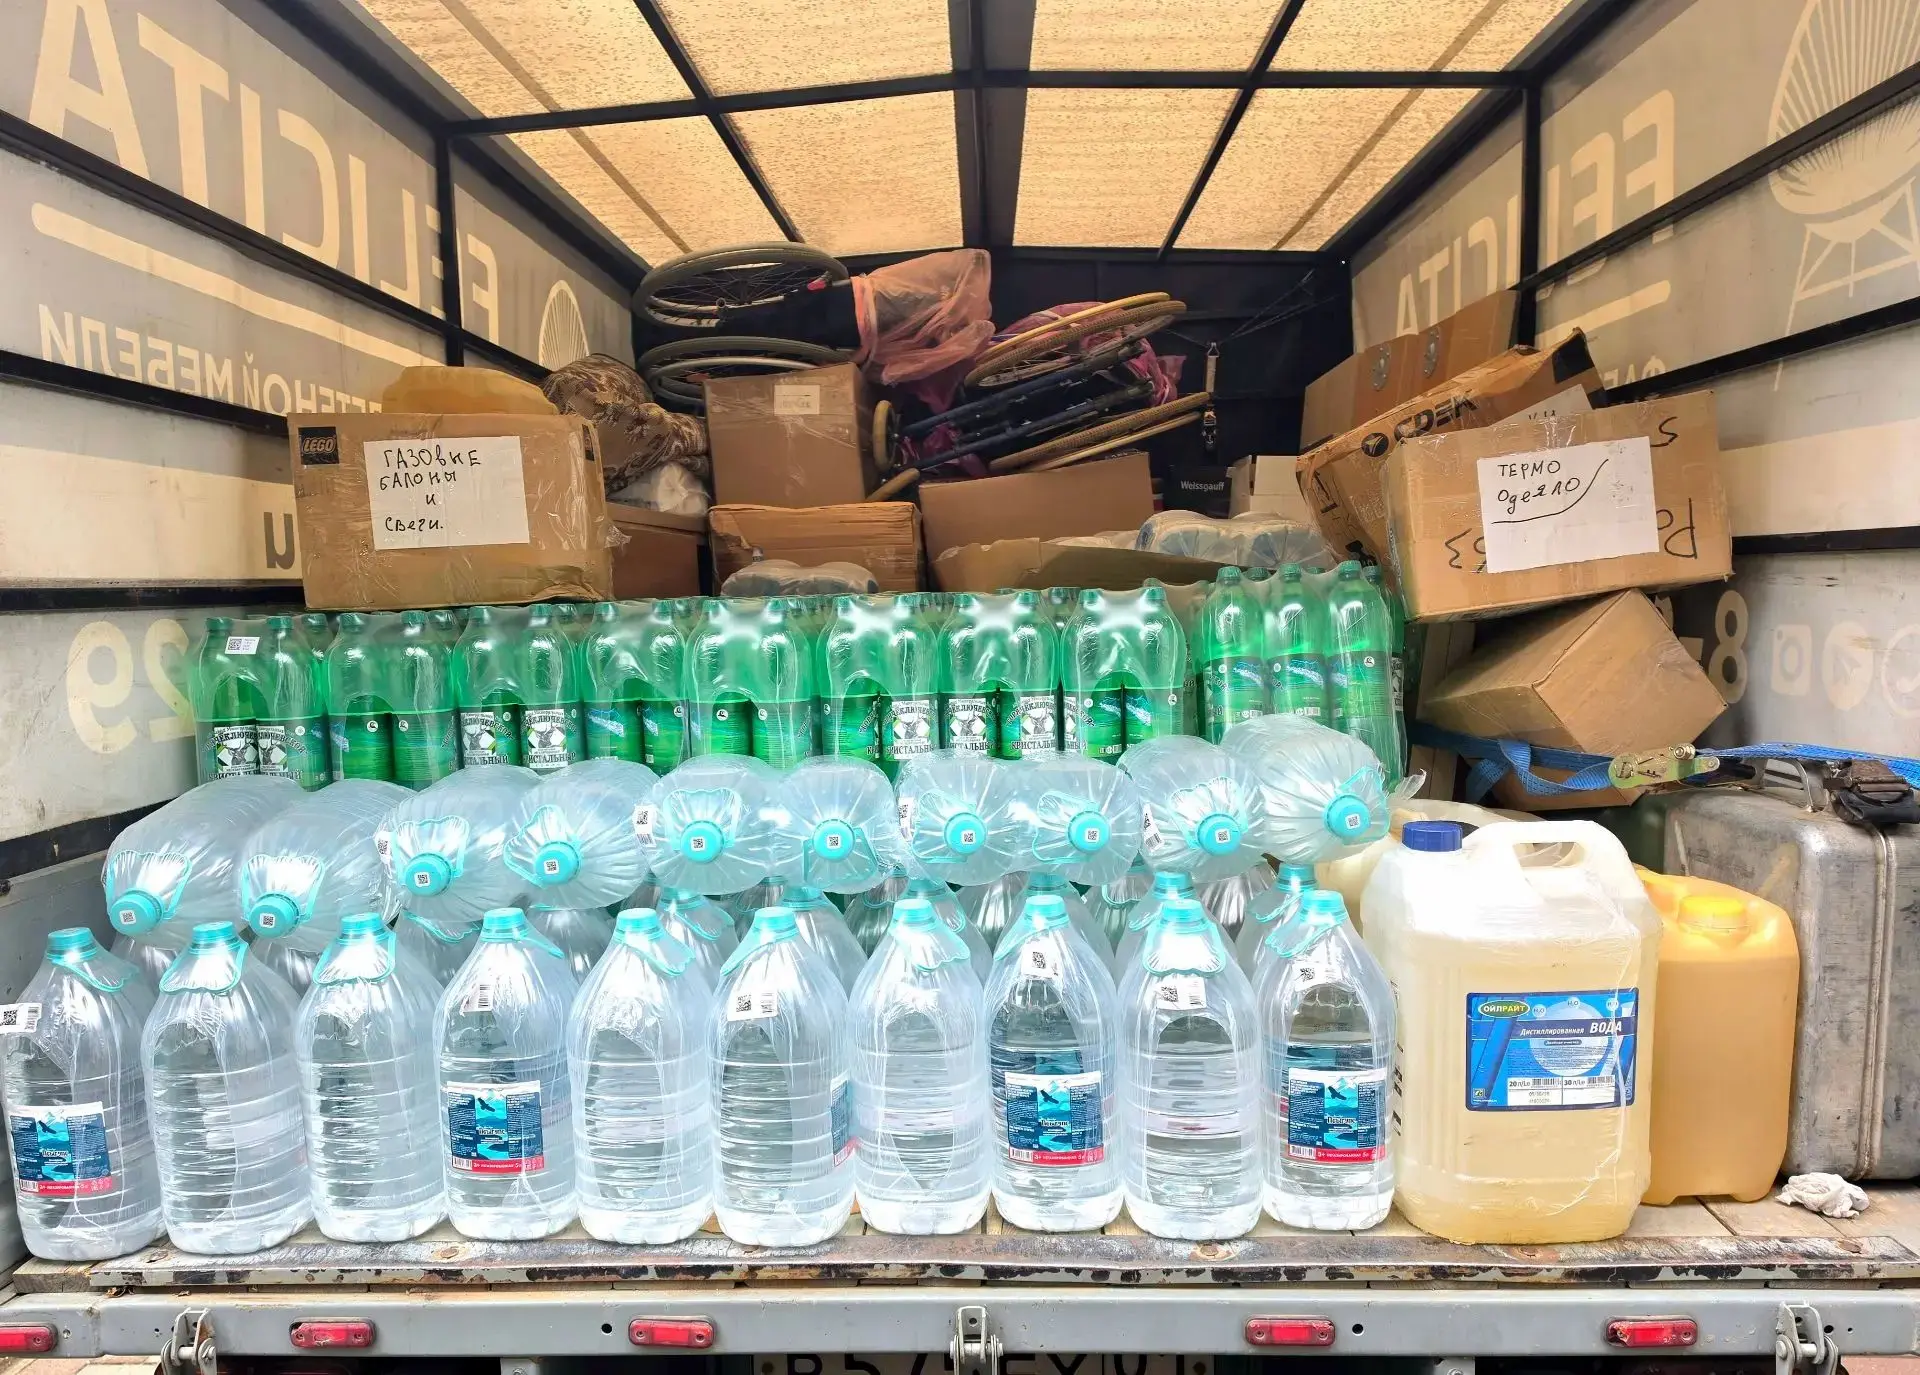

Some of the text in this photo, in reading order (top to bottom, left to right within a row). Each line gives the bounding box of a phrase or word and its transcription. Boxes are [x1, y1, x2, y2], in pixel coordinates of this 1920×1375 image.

[303, 435, 335, 453] LEGO
[1180, 480, 1225, 492] Weissgauff
[1483, 1003, 1526, 1013] ОЙЛРАЙТ
[1590, 1020, 1622, 1035] ВОДА
